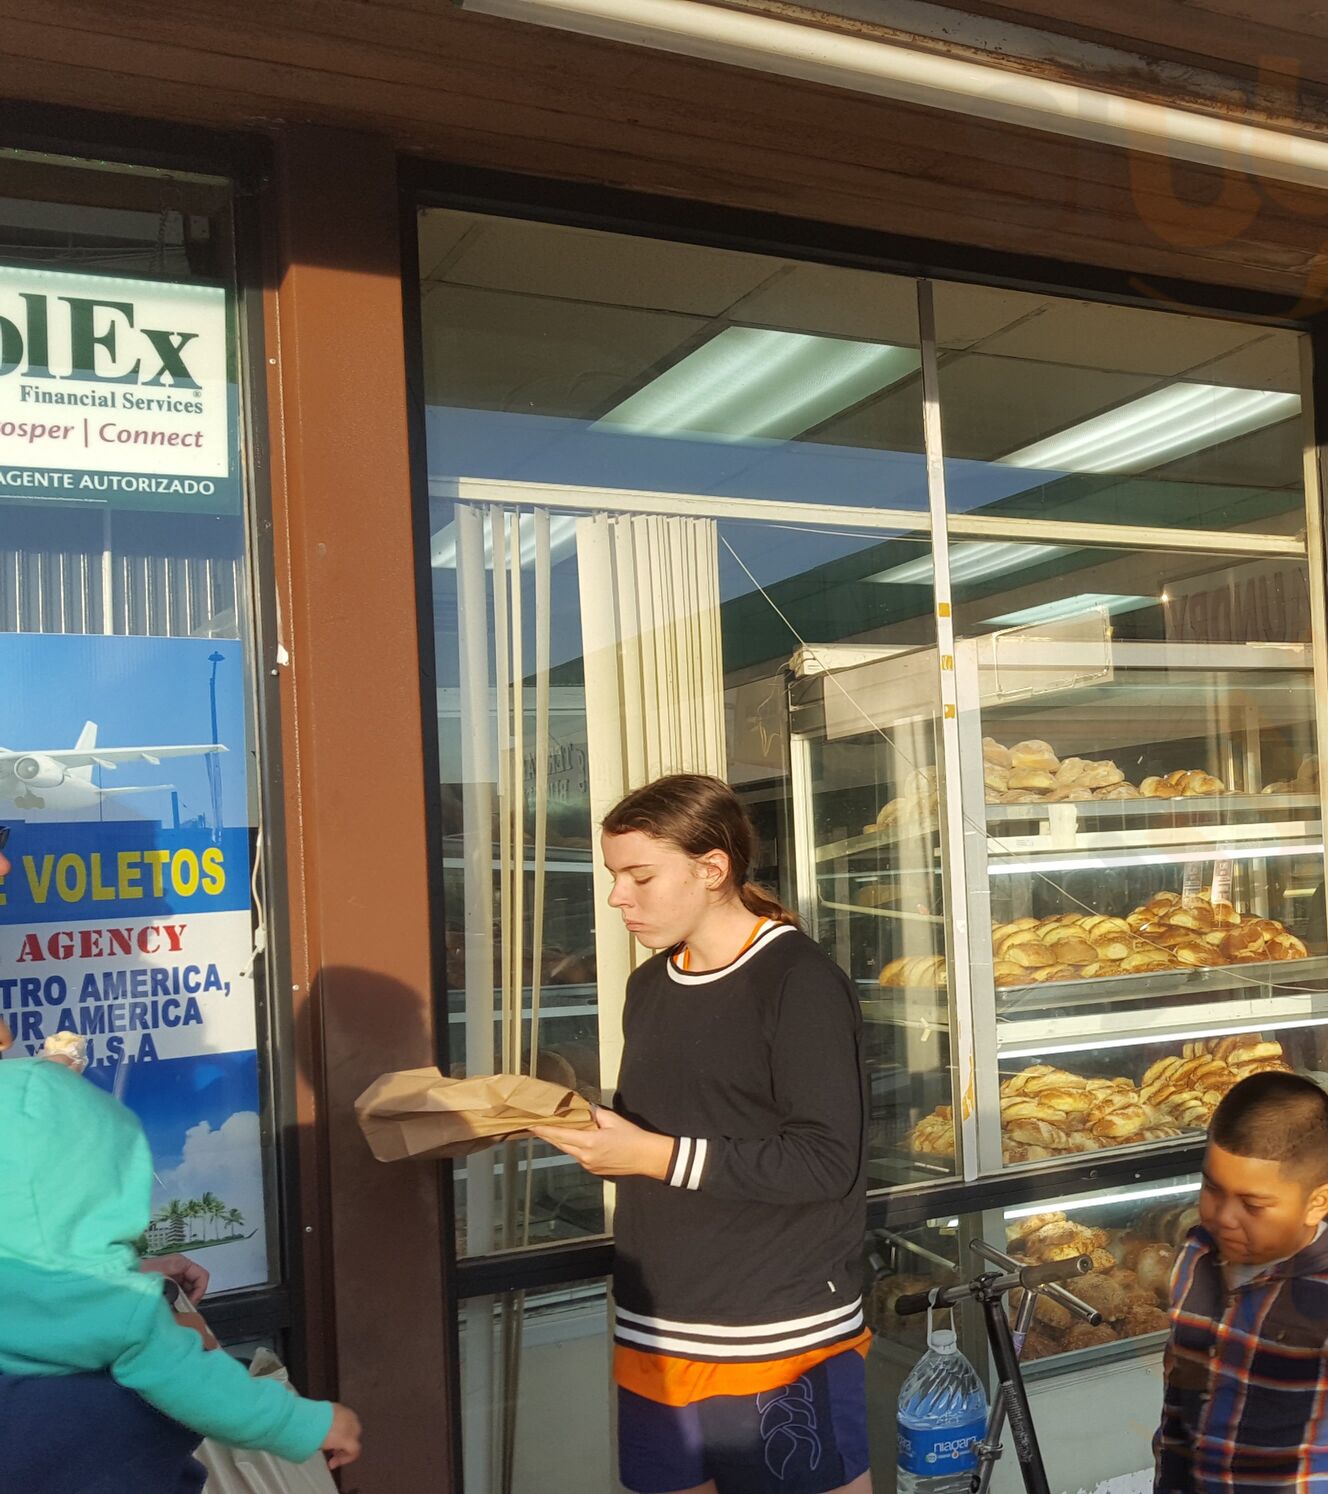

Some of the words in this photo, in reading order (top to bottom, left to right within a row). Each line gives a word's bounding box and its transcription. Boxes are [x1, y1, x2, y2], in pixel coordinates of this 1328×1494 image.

[20, 384, 116, 408] Financial
[123, 392, 203, 414] Services
[99, 423, 204, 448] Connect
[79, 476, 215, 495] AUTORIZADO
[22, 847, 226, 904] VOLETOS
[16, 924, 187, 963] AGENCY
[79, 964, 231, 1004] AMERICA,
[56, 997, 203, 1036] AMERICA
